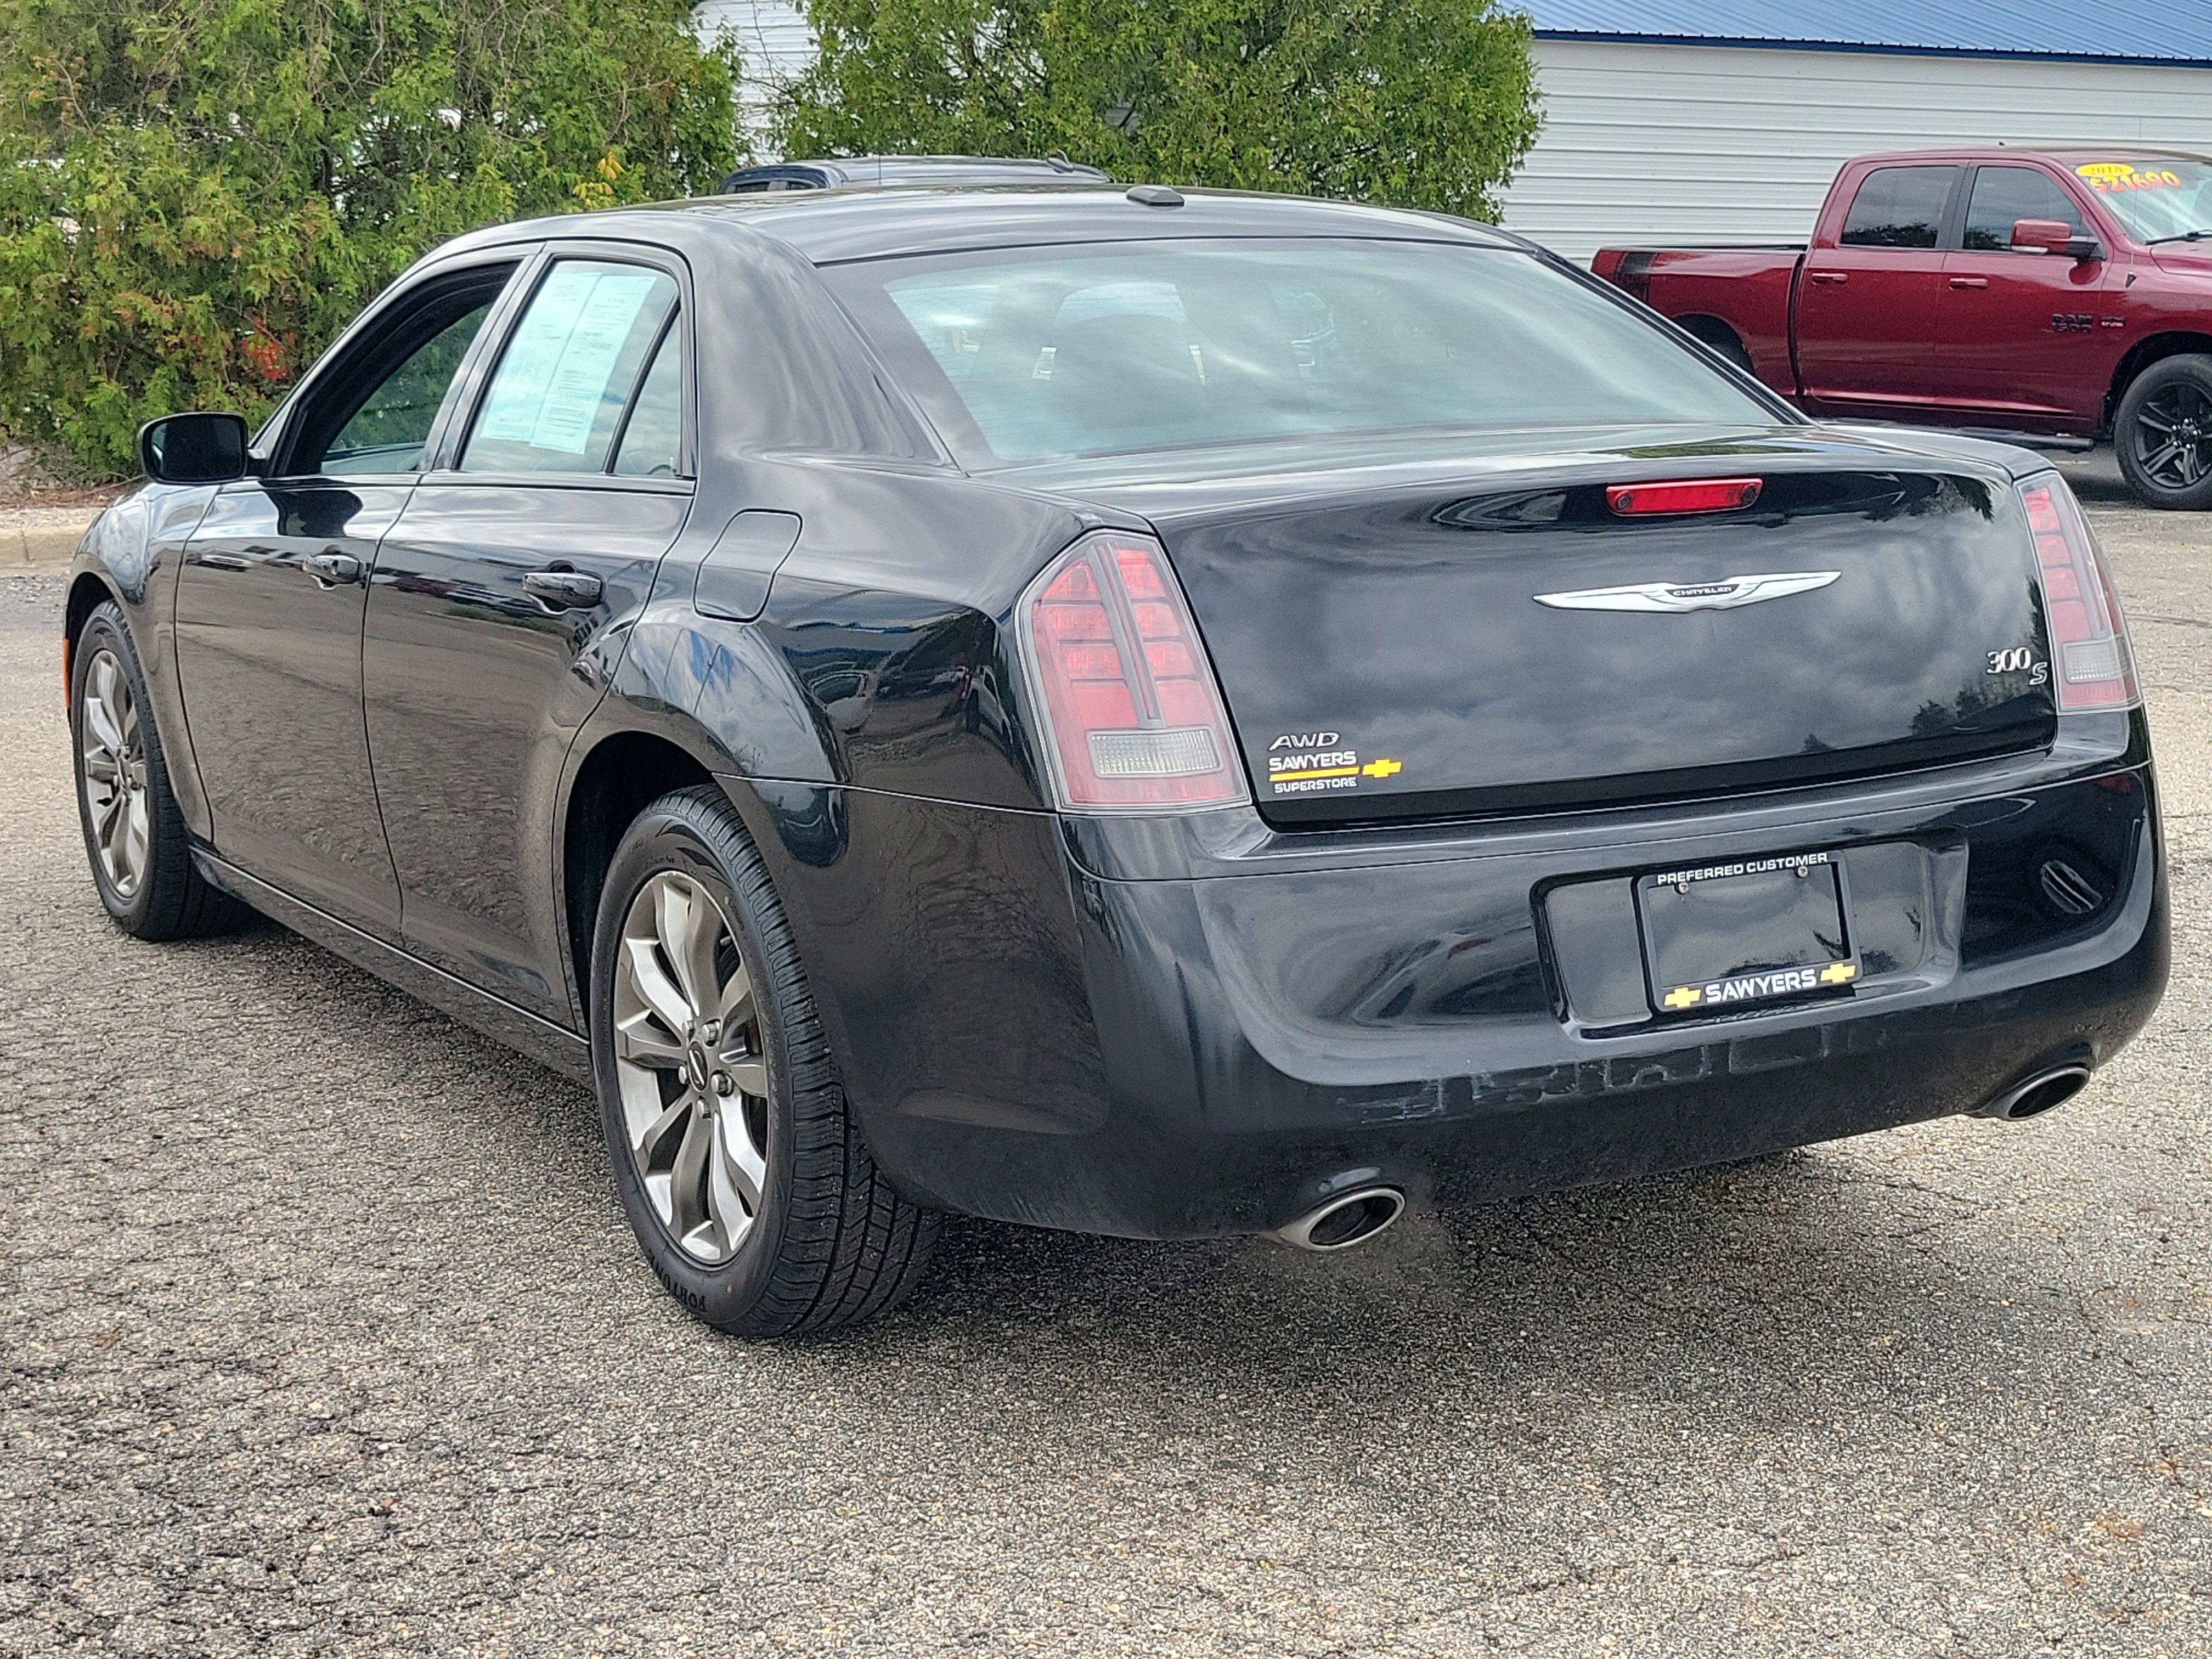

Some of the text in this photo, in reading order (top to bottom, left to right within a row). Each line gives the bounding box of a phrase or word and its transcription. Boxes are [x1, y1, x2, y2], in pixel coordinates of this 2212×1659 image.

[1673, 586, 1732, 596] CHRYSLER
[1987, 647, 2047, 685] 300 S
[1268, 732, 1339, 751] AWD
[1269, 751, 1357, 771] SAWYERS
[1274, 777, 1358, 793] SUPERSTORE
[1657, 852, 1828, 885] PREFERRED CUSTOMER
[1705, 968, 1817, 1003] SAWYERS
